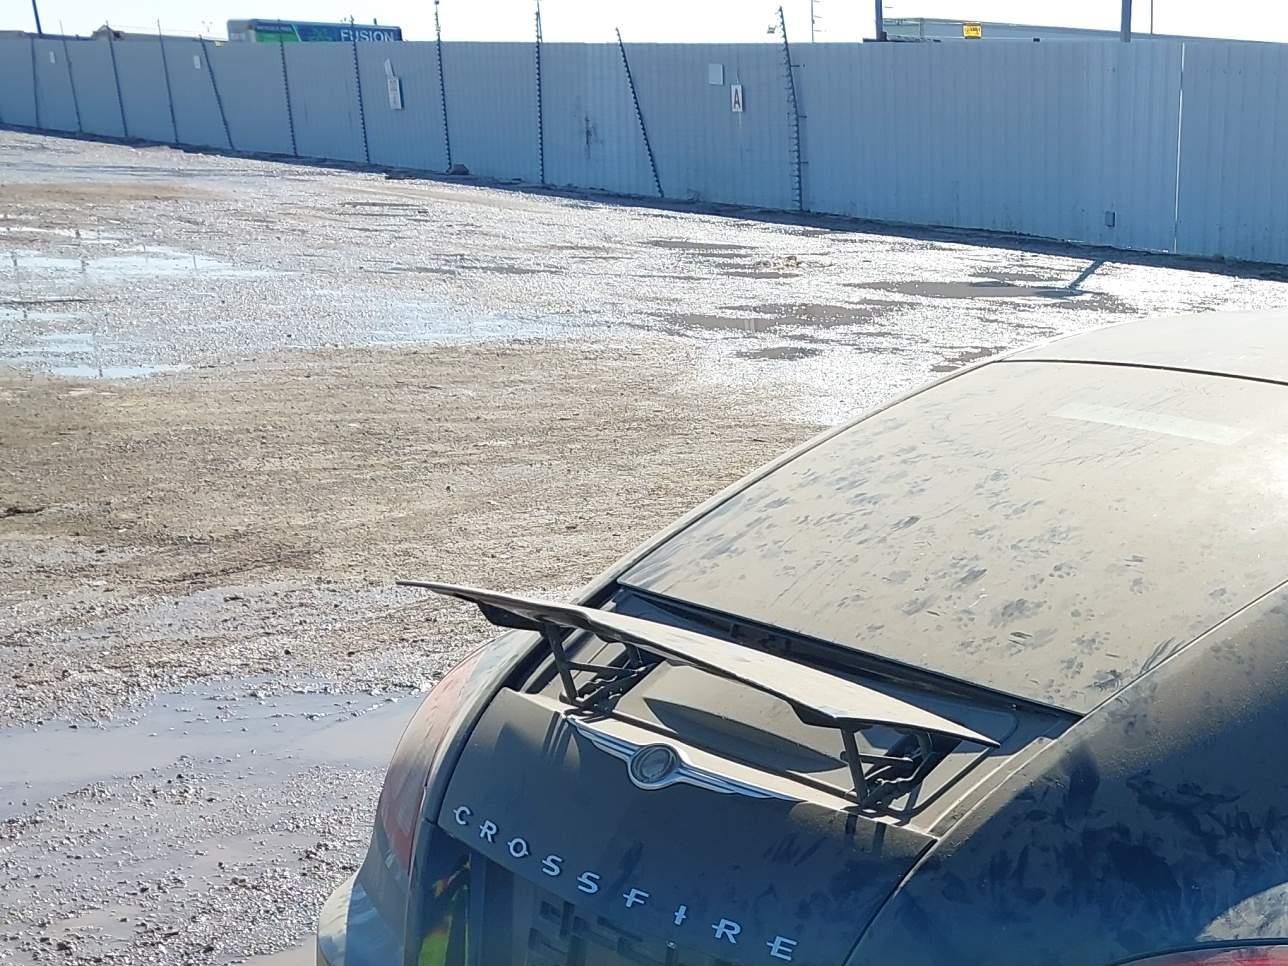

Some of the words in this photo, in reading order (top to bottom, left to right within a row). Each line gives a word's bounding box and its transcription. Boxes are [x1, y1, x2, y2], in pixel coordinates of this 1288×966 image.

[340, 29, 394, 41] FUSION
[733, 89, 741, 109] A
[453, 805, 797, 962] CROSSFIRE
